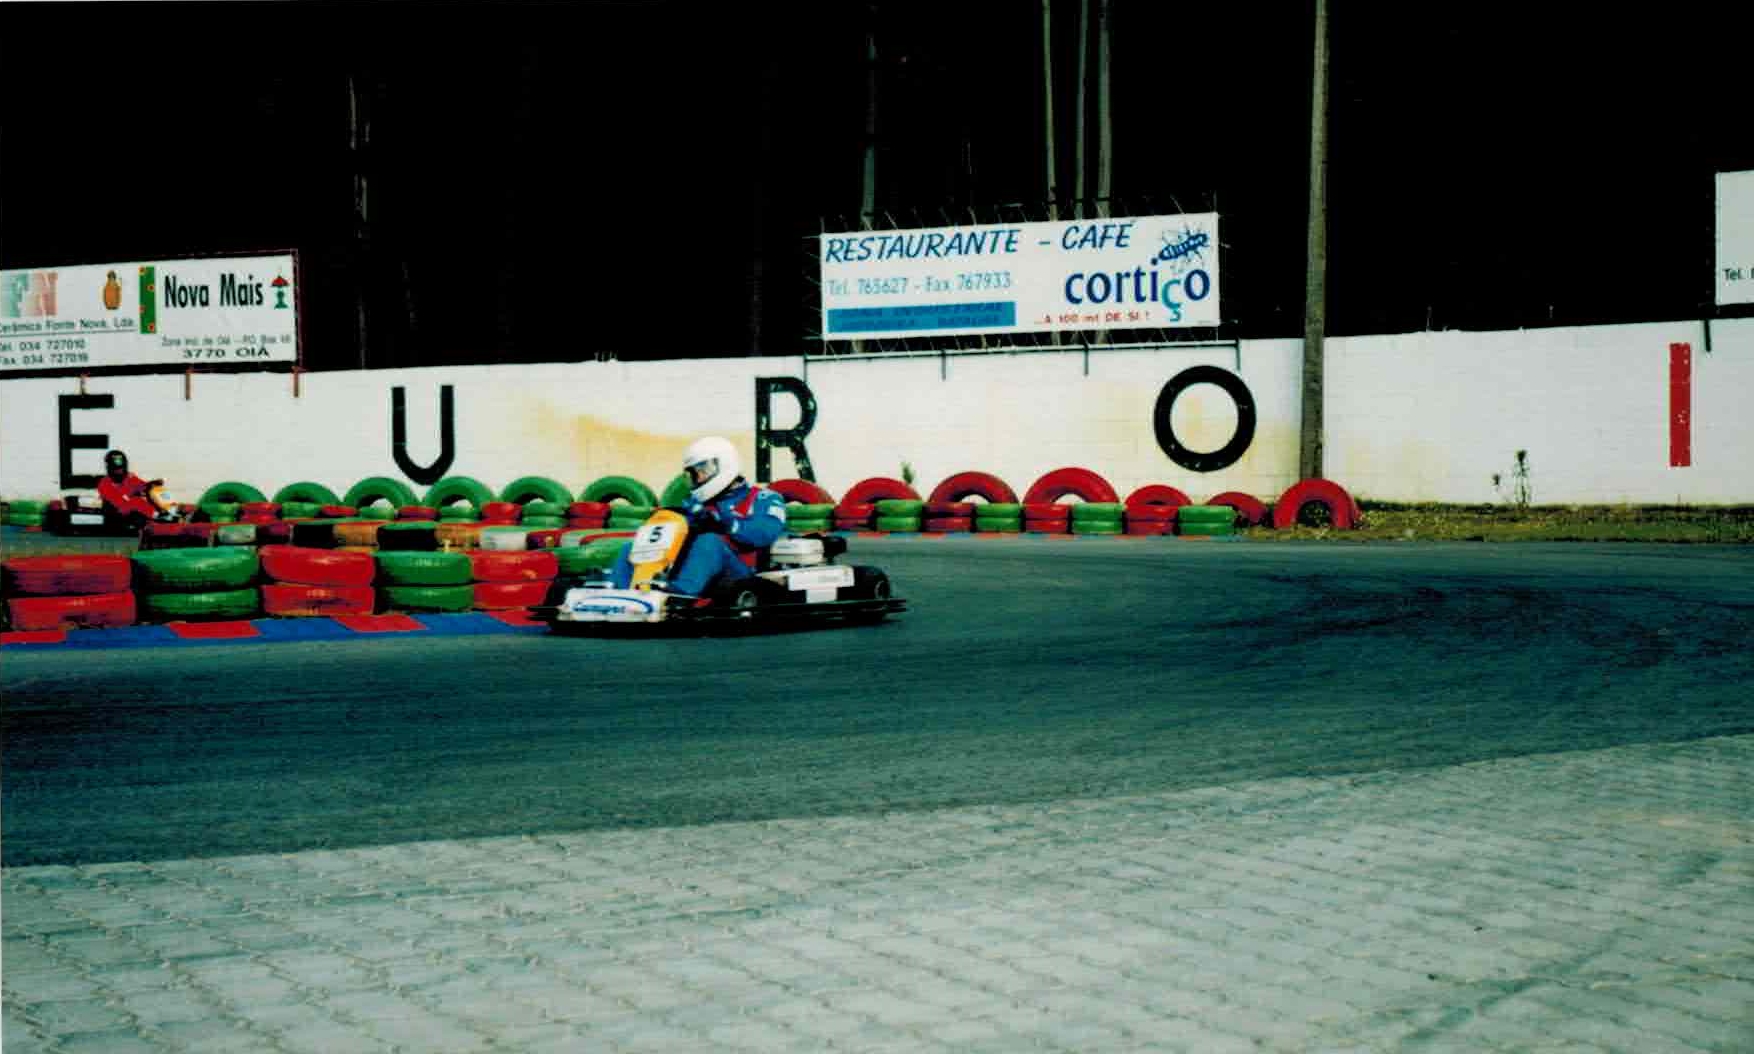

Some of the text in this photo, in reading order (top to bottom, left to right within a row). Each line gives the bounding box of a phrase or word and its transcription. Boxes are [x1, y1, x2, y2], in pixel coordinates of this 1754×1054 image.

[825, 228, 1020, 263] RESTAURANTE
[164, 272, 264, 309] Nova Mais
[1064, 257, 1211, 323] cortiço
[182, 347, 226, 359] 3770
[649, 525, 664, 544] 5
